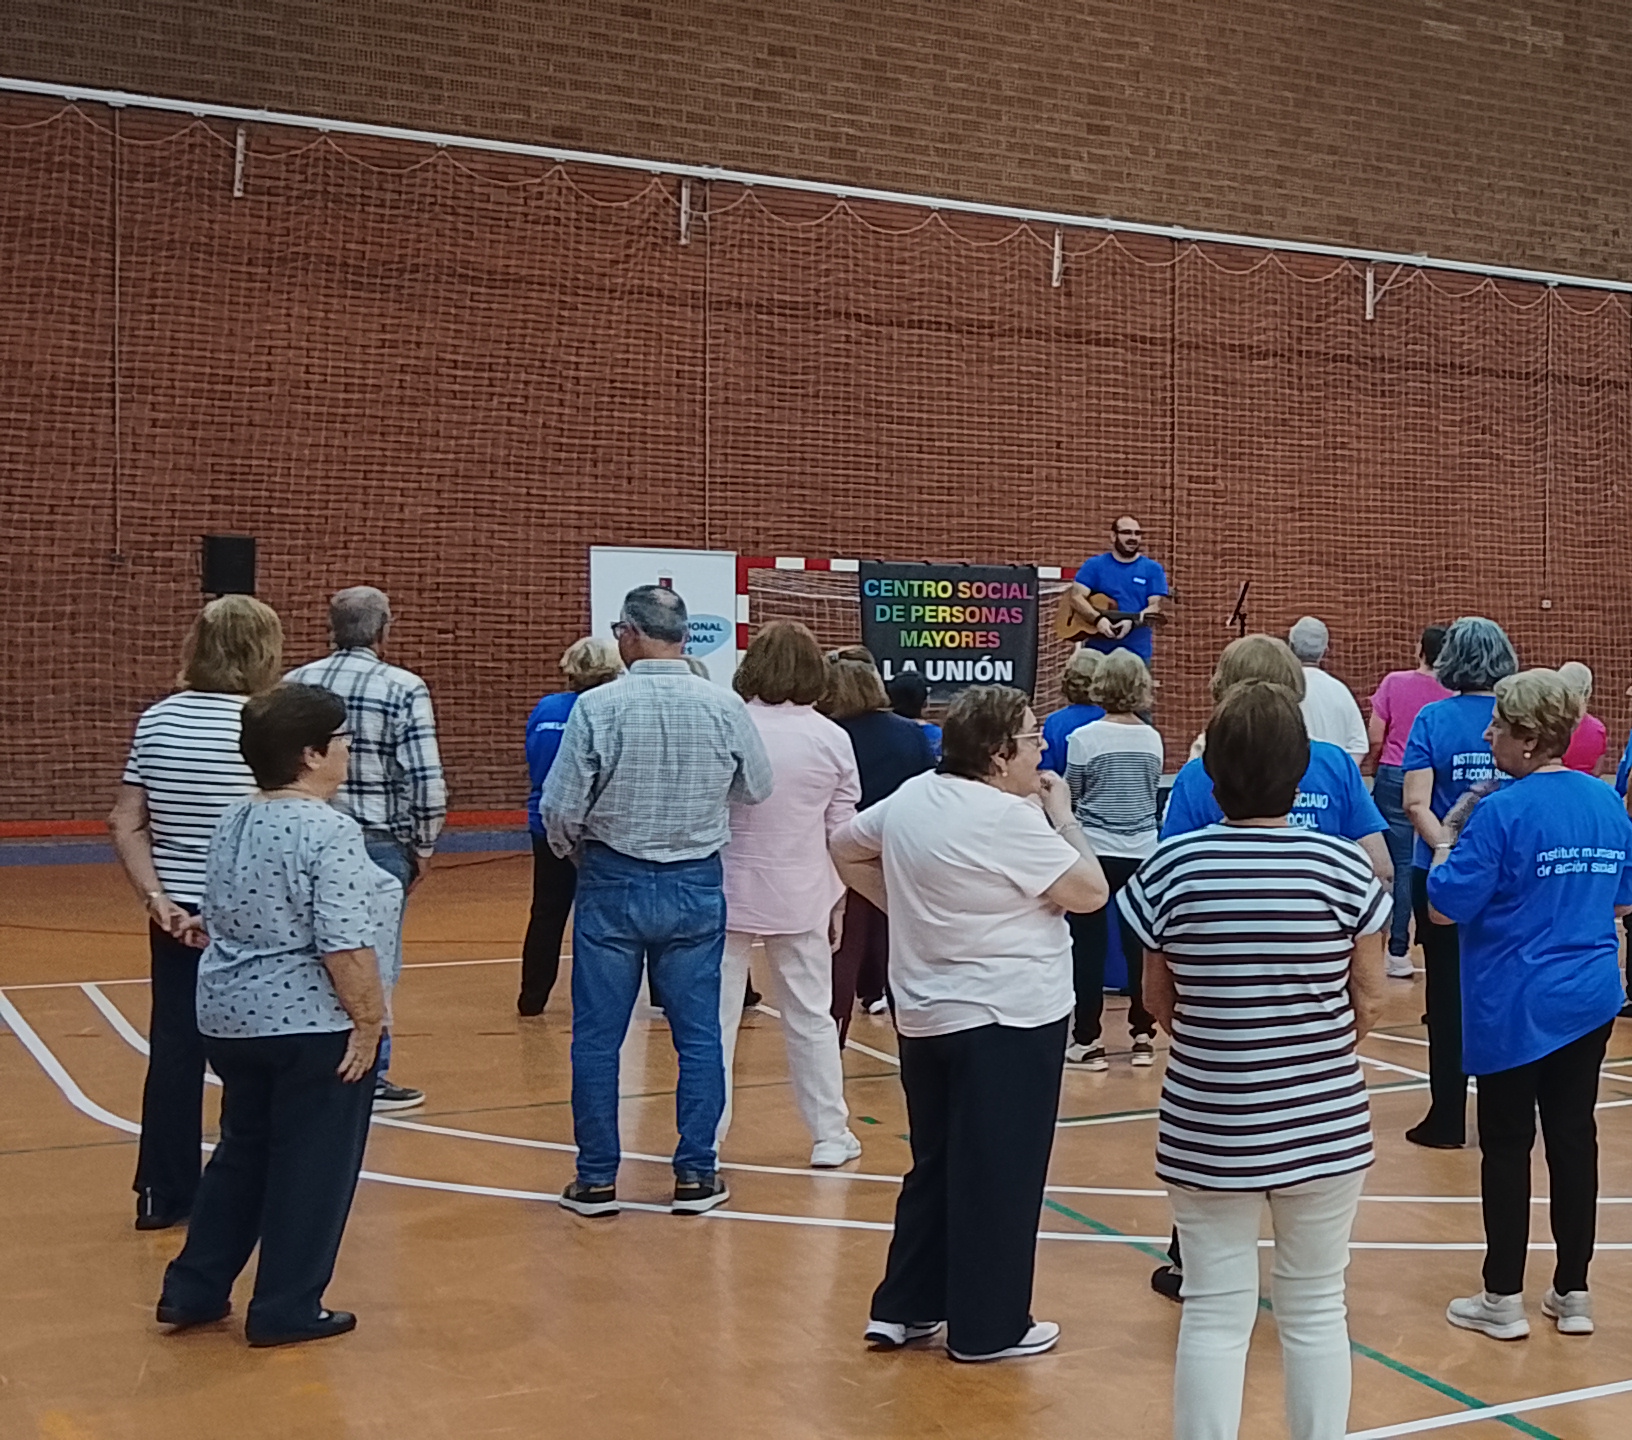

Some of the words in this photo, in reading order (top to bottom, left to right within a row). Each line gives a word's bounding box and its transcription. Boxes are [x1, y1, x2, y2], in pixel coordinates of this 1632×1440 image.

[863, 579, 953, 598] CENTRO
[957, 581, 1035, 600] SOCIAL
[875, 605, 905, 622] DE
[910, 605, 1023, 624] PERSONAS
[900, 630, 1001, 648] MAYORES
[925, 655, 1014, 681] UNIÓN
[1293, 792, 1329, 809] CIANO
[1287, 812, 1319, 830] OCIAL
